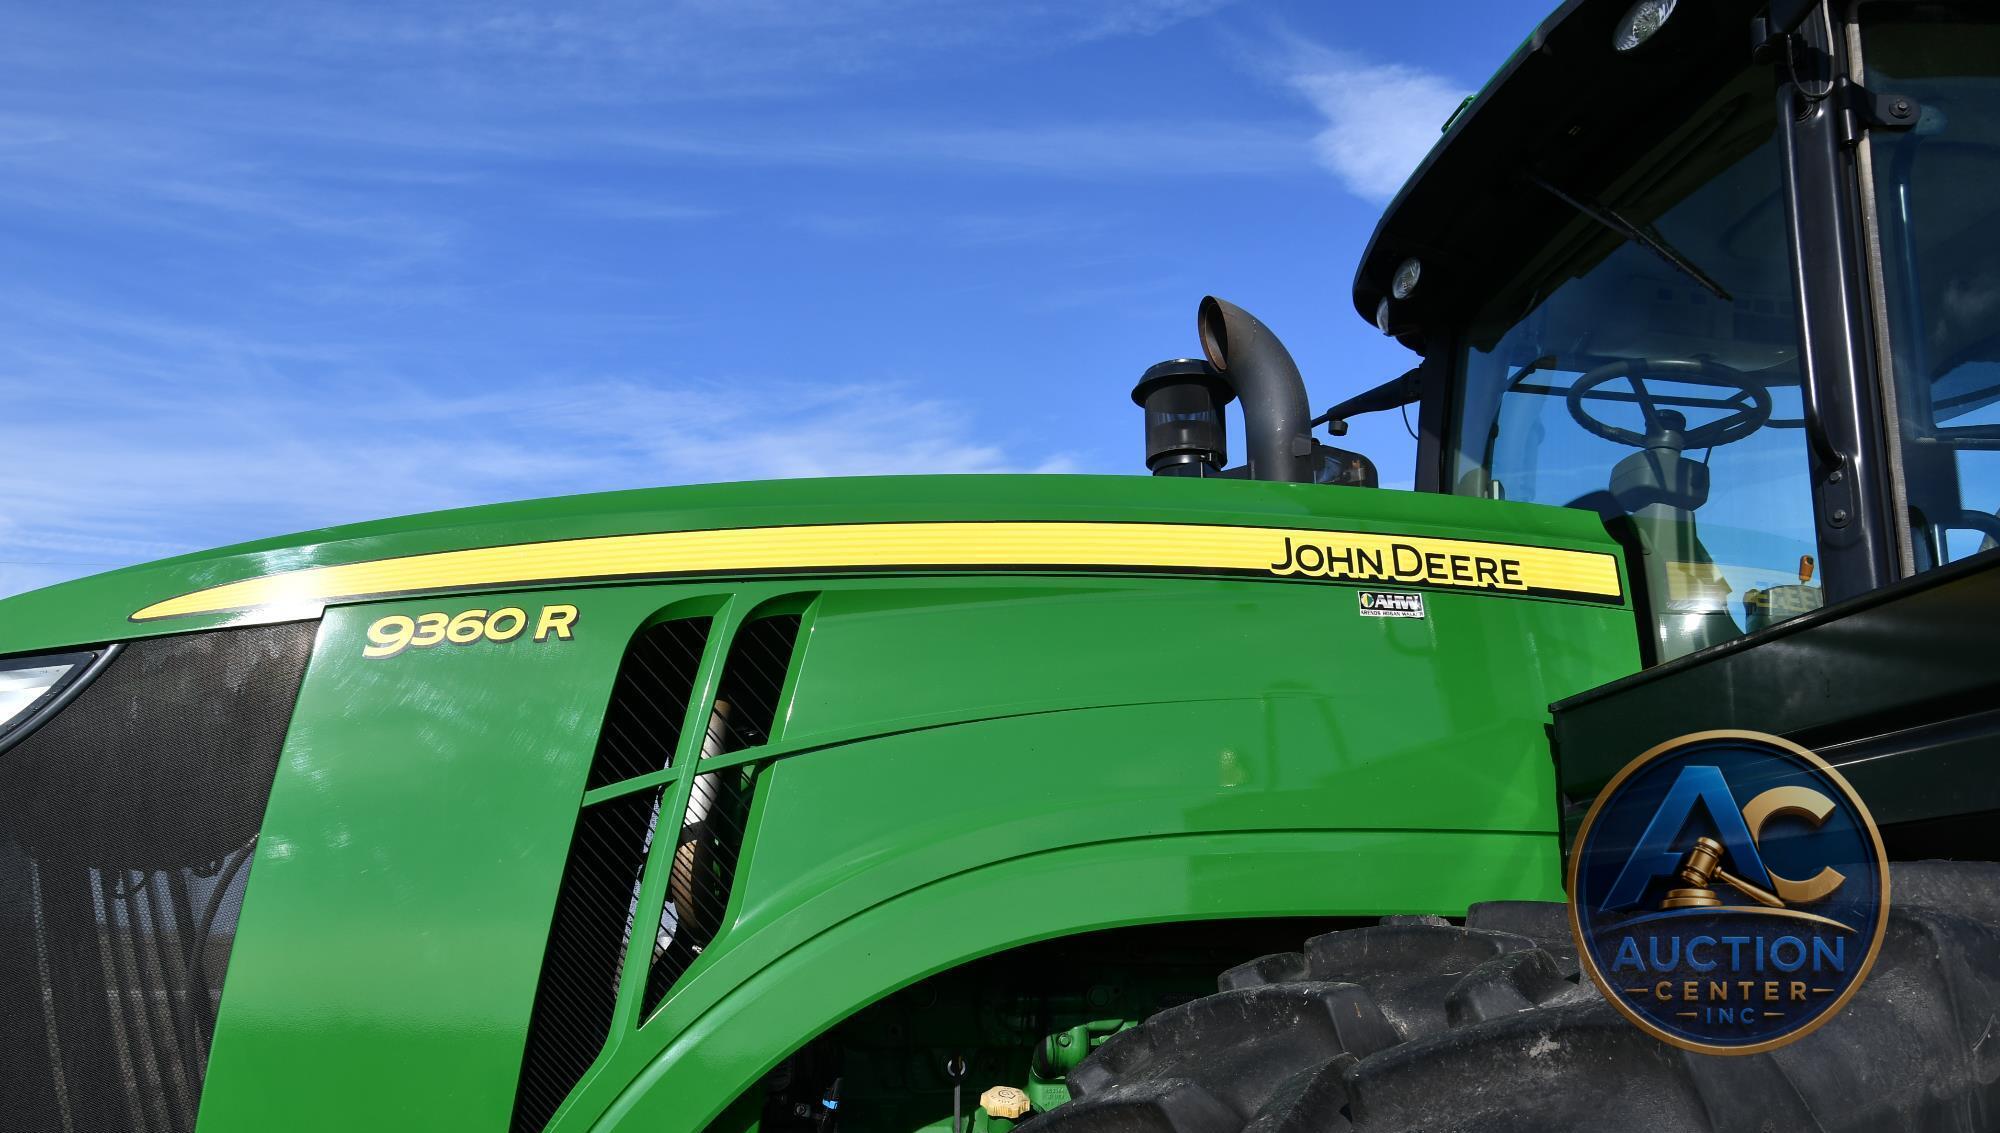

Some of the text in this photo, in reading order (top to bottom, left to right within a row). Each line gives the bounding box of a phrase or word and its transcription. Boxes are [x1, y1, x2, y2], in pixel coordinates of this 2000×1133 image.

[1270, 536, 1525, 586] JOHN DEERE
[1374, 594, 1419, 610] AHW
[363, 603, 580, 659] 9360 R
